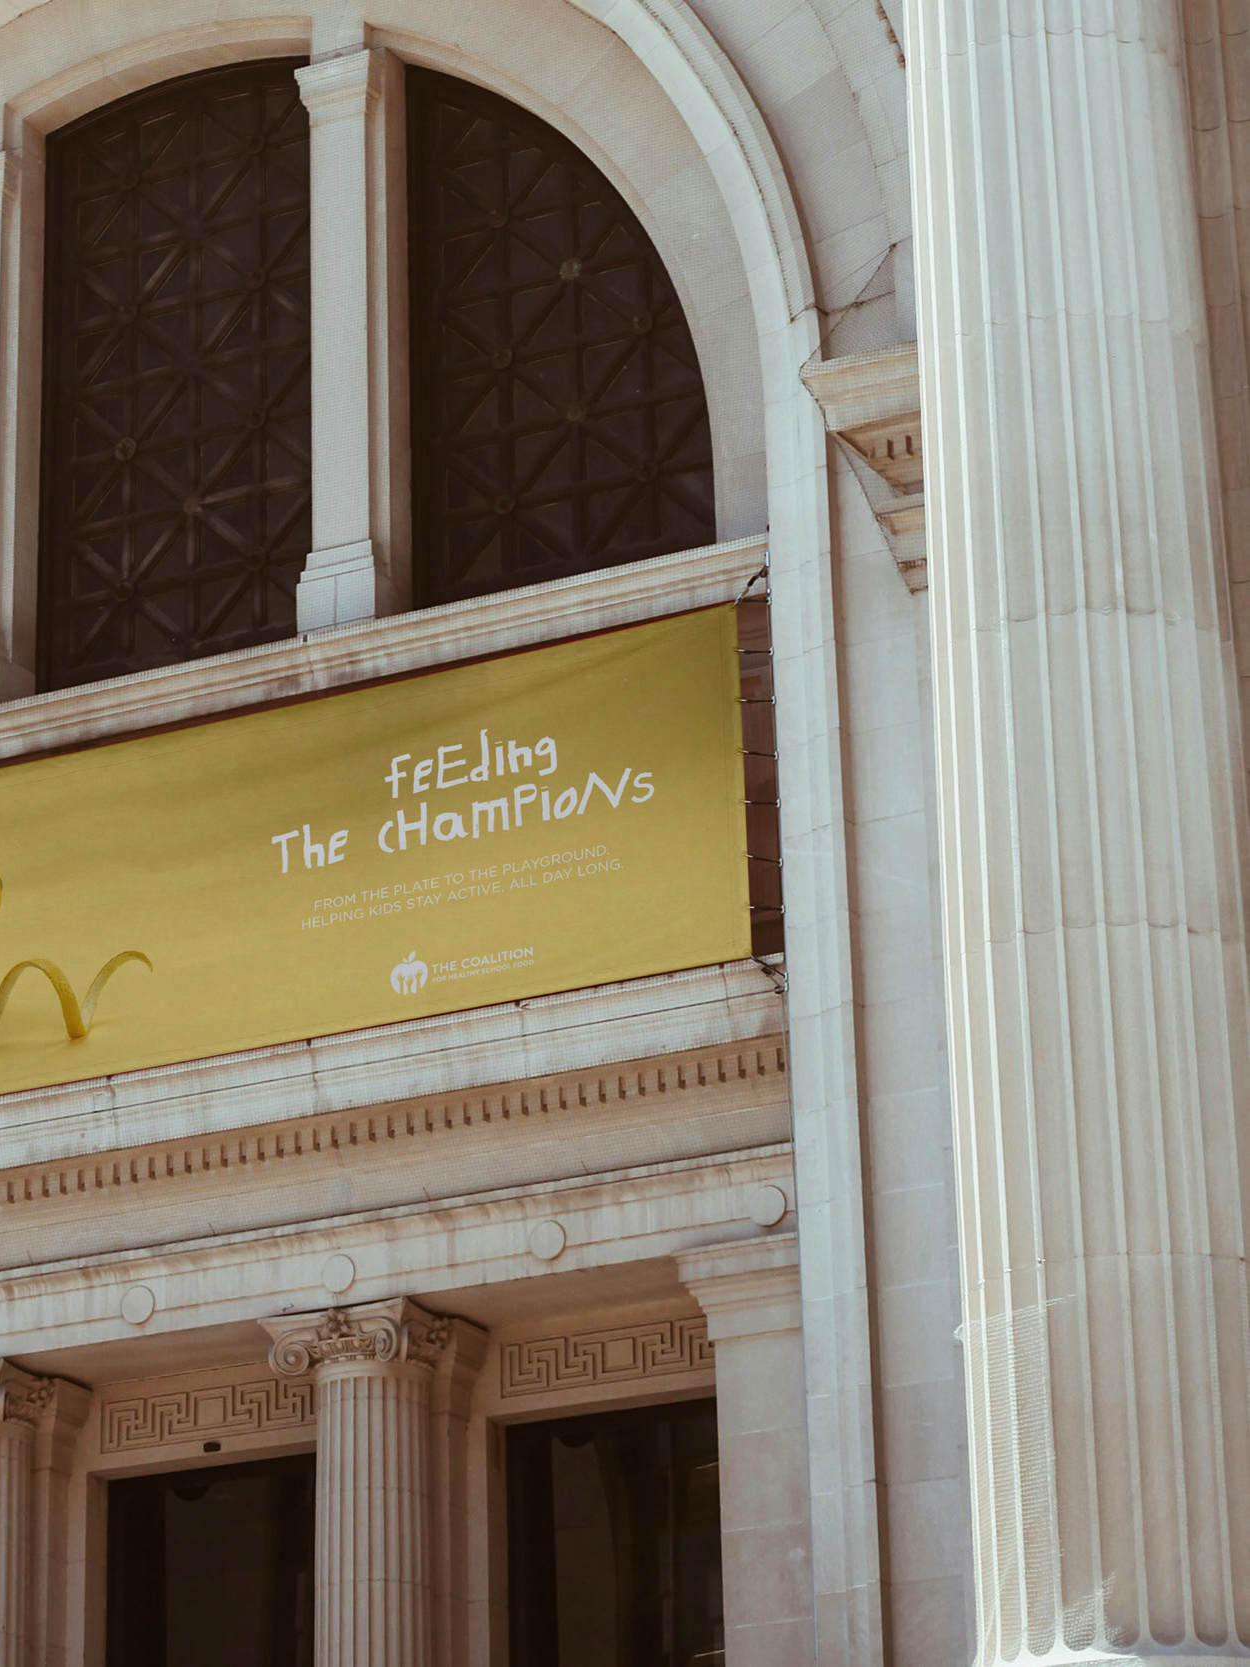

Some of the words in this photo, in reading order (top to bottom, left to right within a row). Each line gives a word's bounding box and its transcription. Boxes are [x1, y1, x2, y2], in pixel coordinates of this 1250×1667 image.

[271, 823, 349, 874] The
[301, 906, 365, 930] HELPING
[369, 900, 402, 917] KIDS
[407, 893, 441, 910] STAY
[447, 882, 504, 902] ACTIVE,
[509, 874, 538, 890] ALL
[542, 867, 575, 883] DAY
[577, 858, 624, 877] LONG.
[314, 894, 356, 911] FROM
[361, 886, 389, 902] THE
[393, 877, 440, 895] PLATE
[444, 872, 464, 888] TO
[469, 865, 498, 882] THE
[503, 844, 610, 875] PLAYGROUND.
[431, 960, 457, 974] THE
[460, 946, 534, 969] COALITION
[432, 975, 447, 984] FOR
[448, 969, 480, 981] HEALTHY
[481, 964, 512, 975] SCHOOL
[513, 959, 535, 969] FOOD
